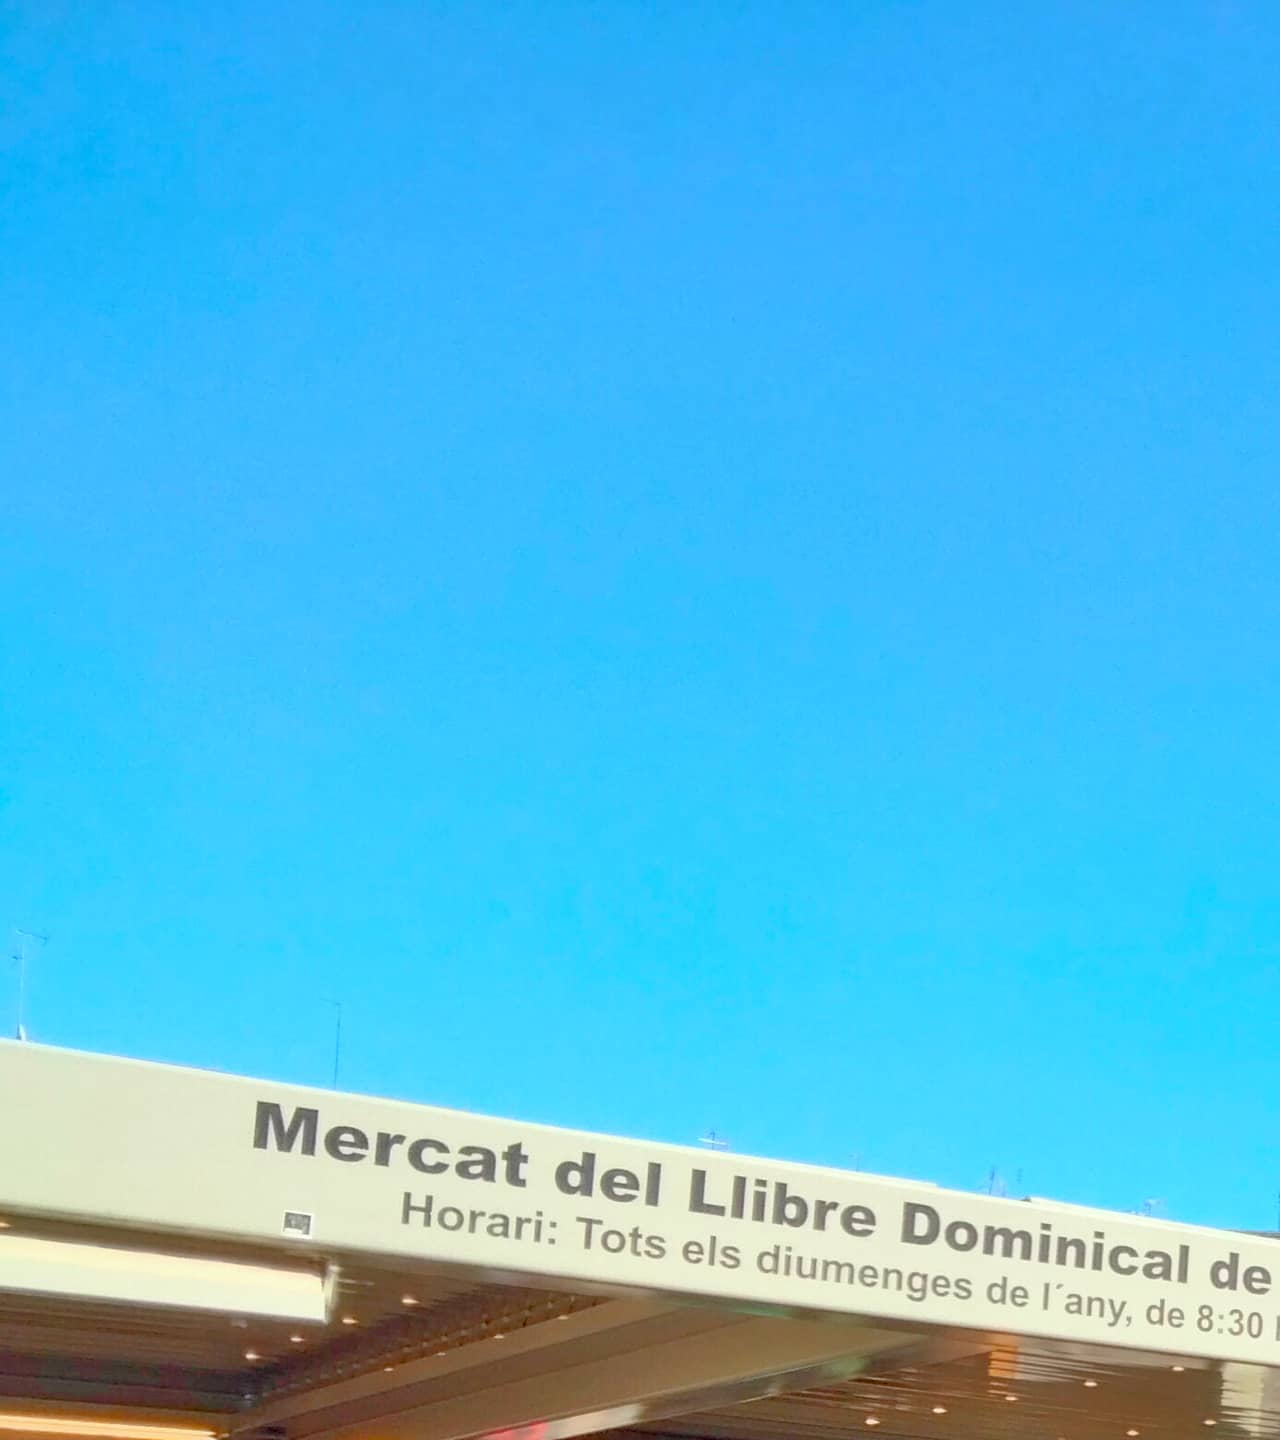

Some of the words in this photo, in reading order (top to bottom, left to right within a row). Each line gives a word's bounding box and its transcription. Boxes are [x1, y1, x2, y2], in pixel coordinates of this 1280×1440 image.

[252, 1099, 530, 1189] Mercat
[554, 1151, 664, 1208] del
[687, 1167, 878, 1238] Llibre
[900, 1201, 1191, 1285] Dominical
[1209, 1251, 1273, 1296] de
[401, 1191, 557, 1246] Horari:
[575, 1215, 667, 1260] Tots
[681, 1234, 742, 1270] els
[756, 1243, 973, 1303] diumenges
[986, 1275, 1030, 1308] de
[1145, 1298, 1185, 1329] de
[1196, 1303, 1264, 1339] 8:30
